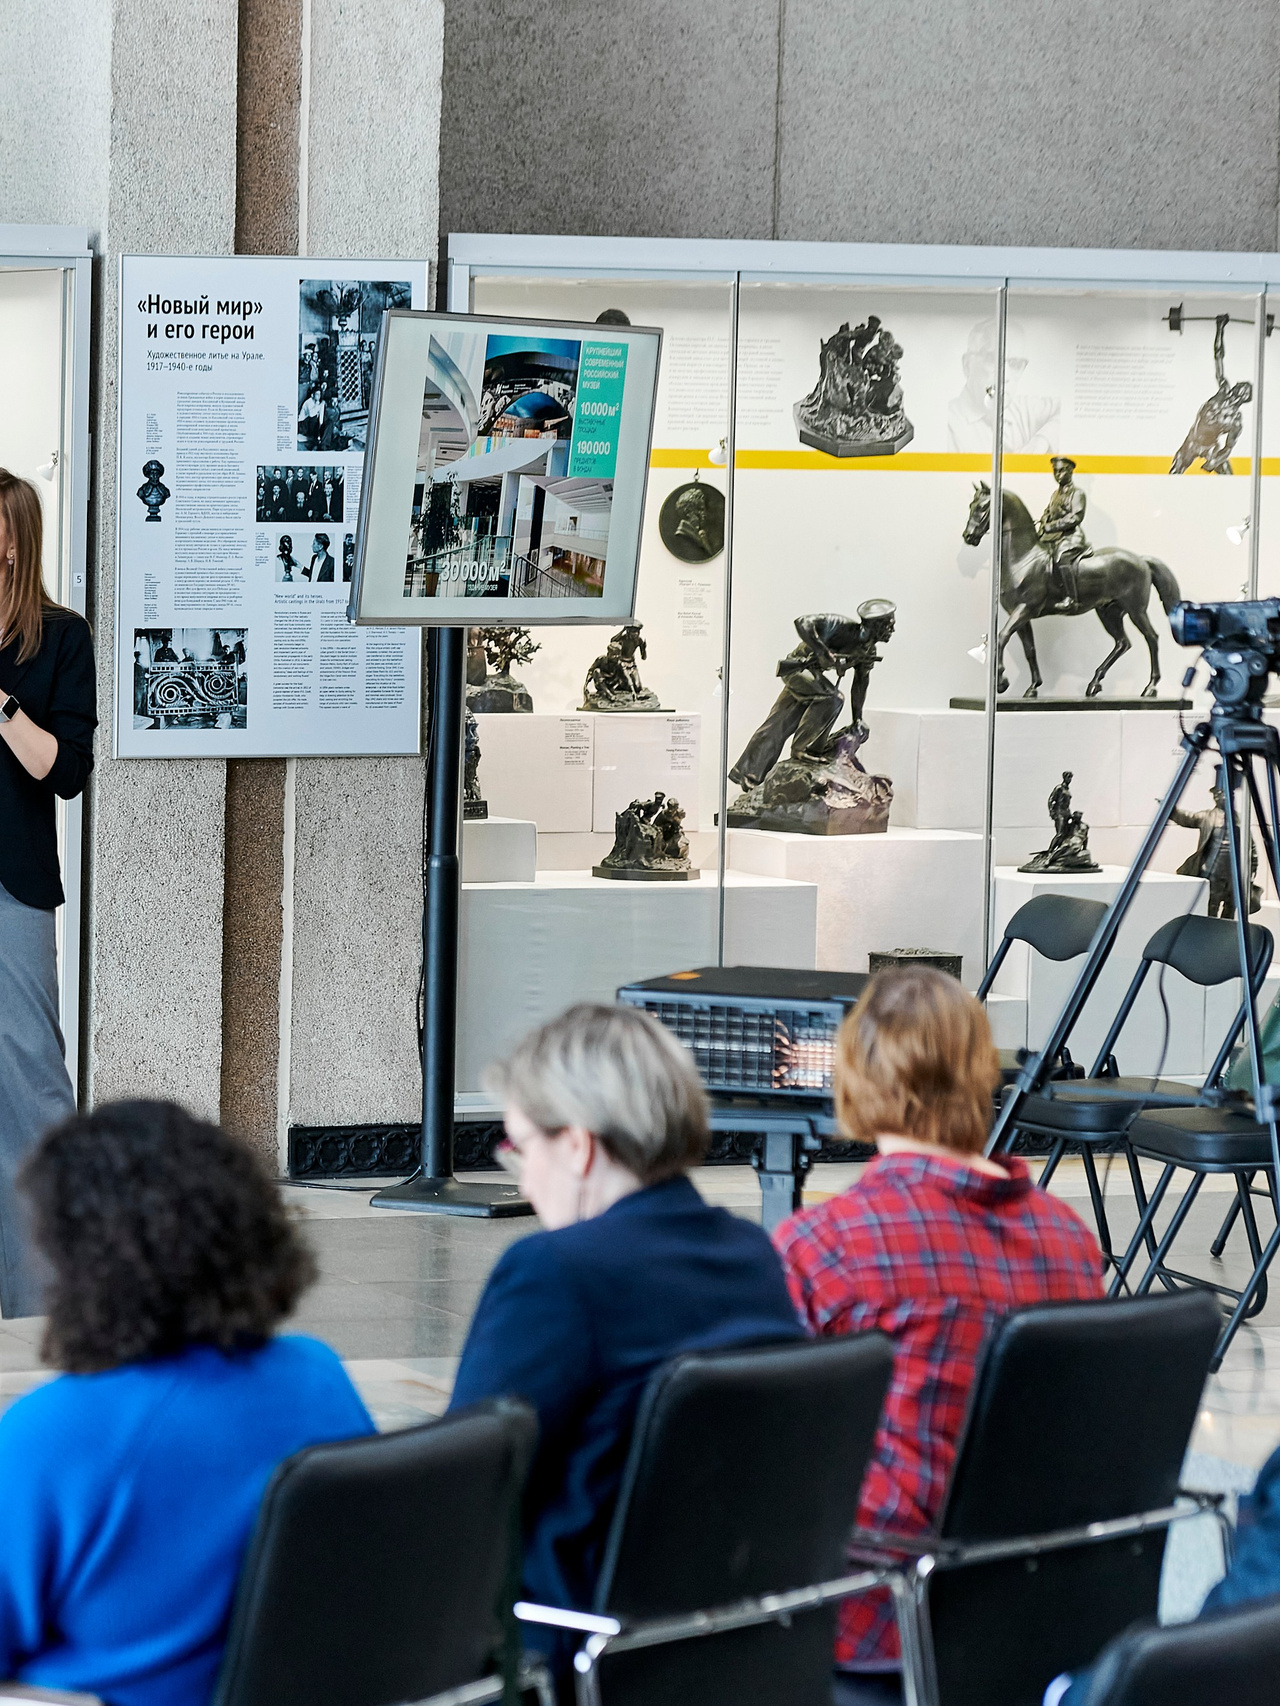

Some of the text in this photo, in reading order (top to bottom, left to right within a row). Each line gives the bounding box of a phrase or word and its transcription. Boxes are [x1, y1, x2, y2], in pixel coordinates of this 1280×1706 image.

[138, 294, 263, 320] «Новый мир»
[147, 324, 254, 344] и его герои
[147, 350, 206, 362] Художественное
[209, 352, 229, 360] литье
[242, 351, 265, 362] Урале.
[195, 364, 213, 372] годы
[582, 380, 600, 389] МУЗЕЙ
